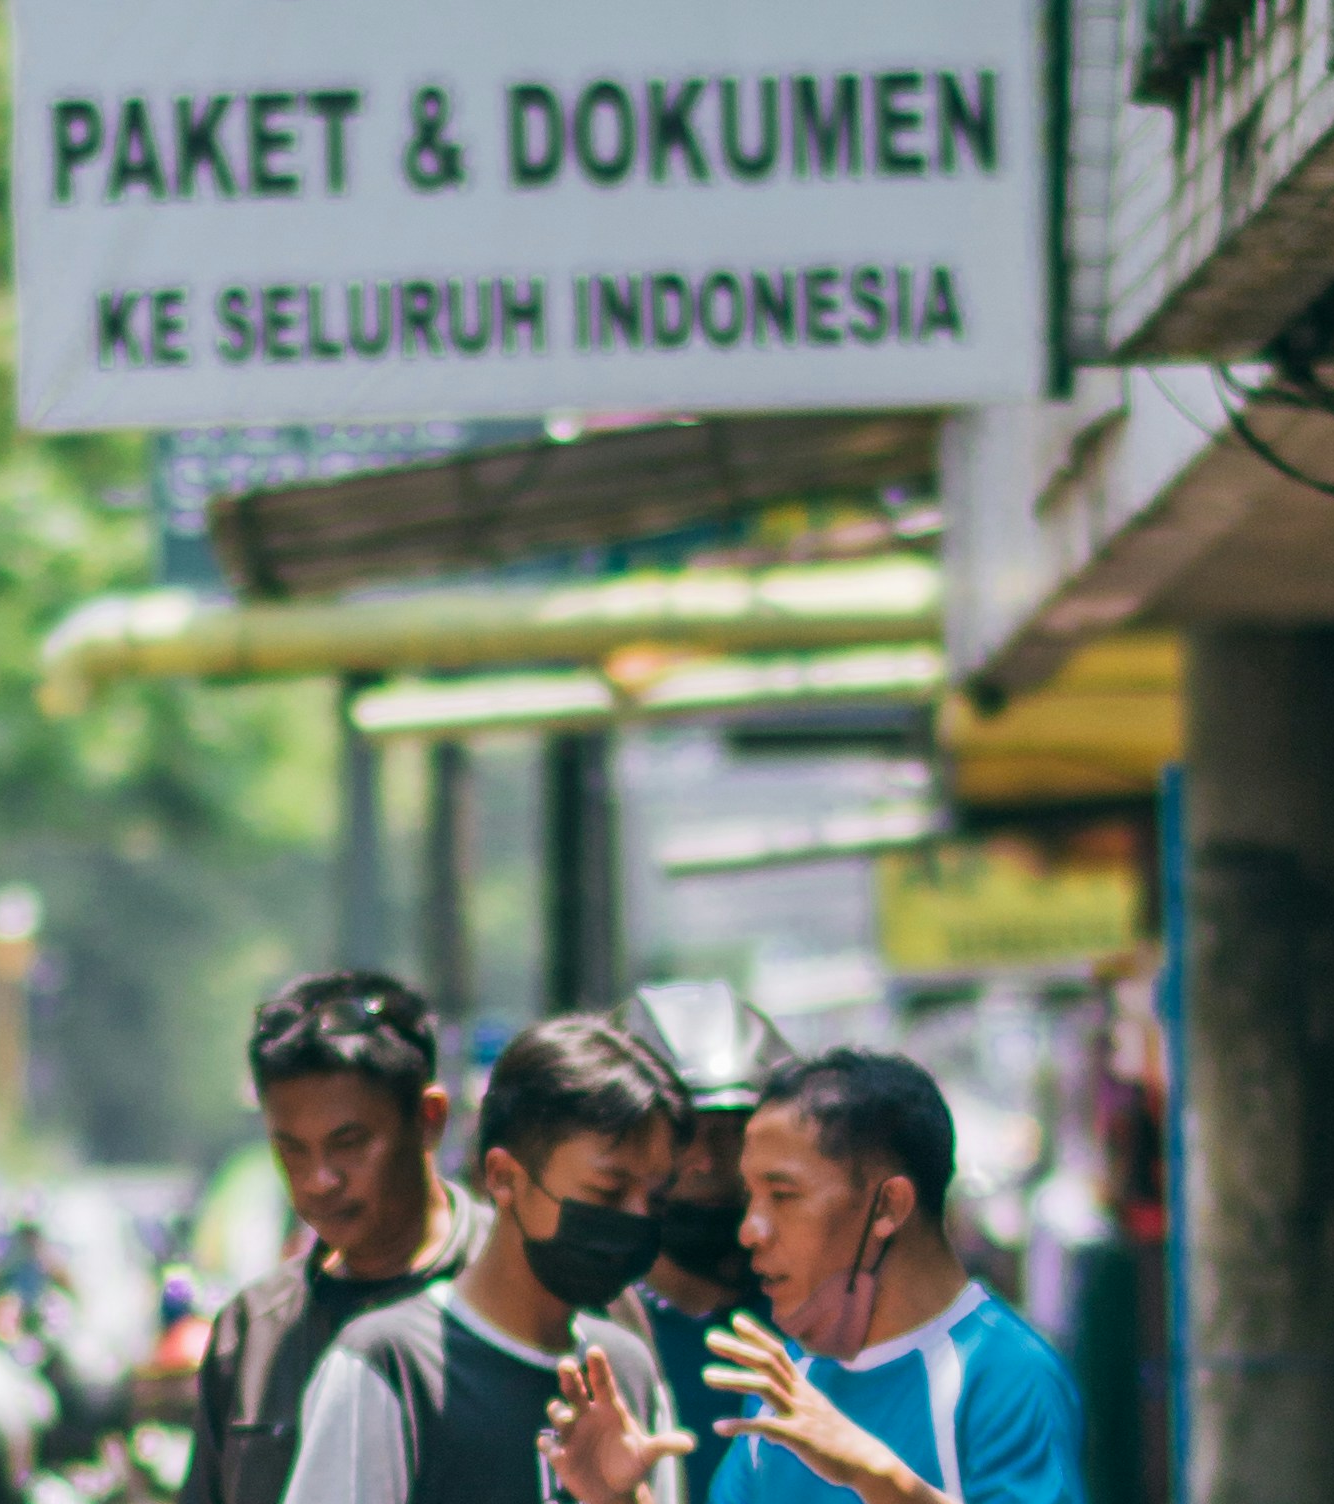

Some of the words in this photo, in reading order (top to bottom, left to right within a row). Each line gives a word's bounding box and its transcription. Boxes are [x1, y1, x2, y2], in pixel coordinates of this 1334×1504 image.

[51, 87, 362, 203] PAKET
[402, 84, 467, 193] &
[507, 68, 999, 189] DOKUMEN
[96, 288, 188, 366] KE
[217, 278, 546, 364] SELURUH
[575, 264, 964, 350] INDONESIA
